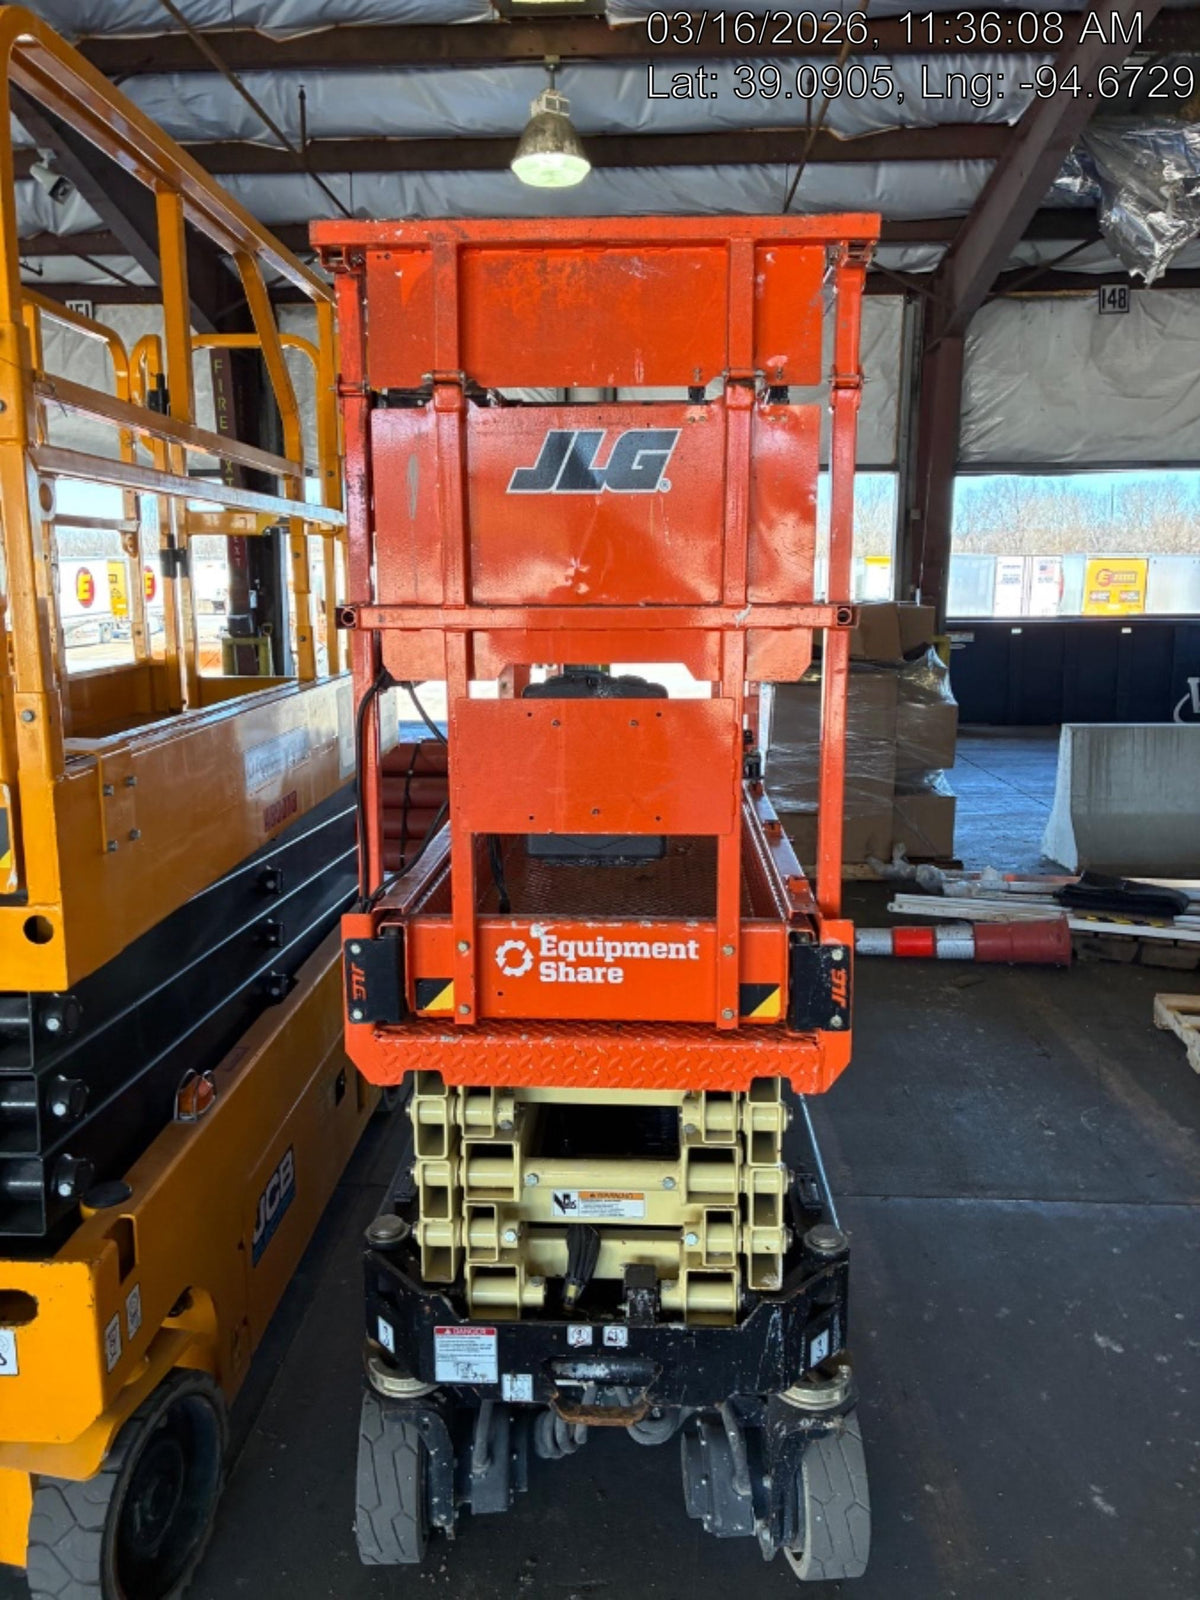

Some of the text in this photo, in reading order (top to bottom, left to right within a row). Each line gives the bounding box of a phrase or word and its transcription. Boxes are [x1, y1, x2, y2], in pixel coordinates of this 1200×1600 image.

[1102, 287, 1127, 309] 148
[214, 359, 228, 429] FIRE
[506, 428, 682, 493] JLG
[539, 934, 699, 962] Equipment
[351, 962, 367, 1001] JLG
[539, 961, 624, 983] Share
[831, 968, 848, 1009] JLG
[253, 1150, 294, 1244] JCB
